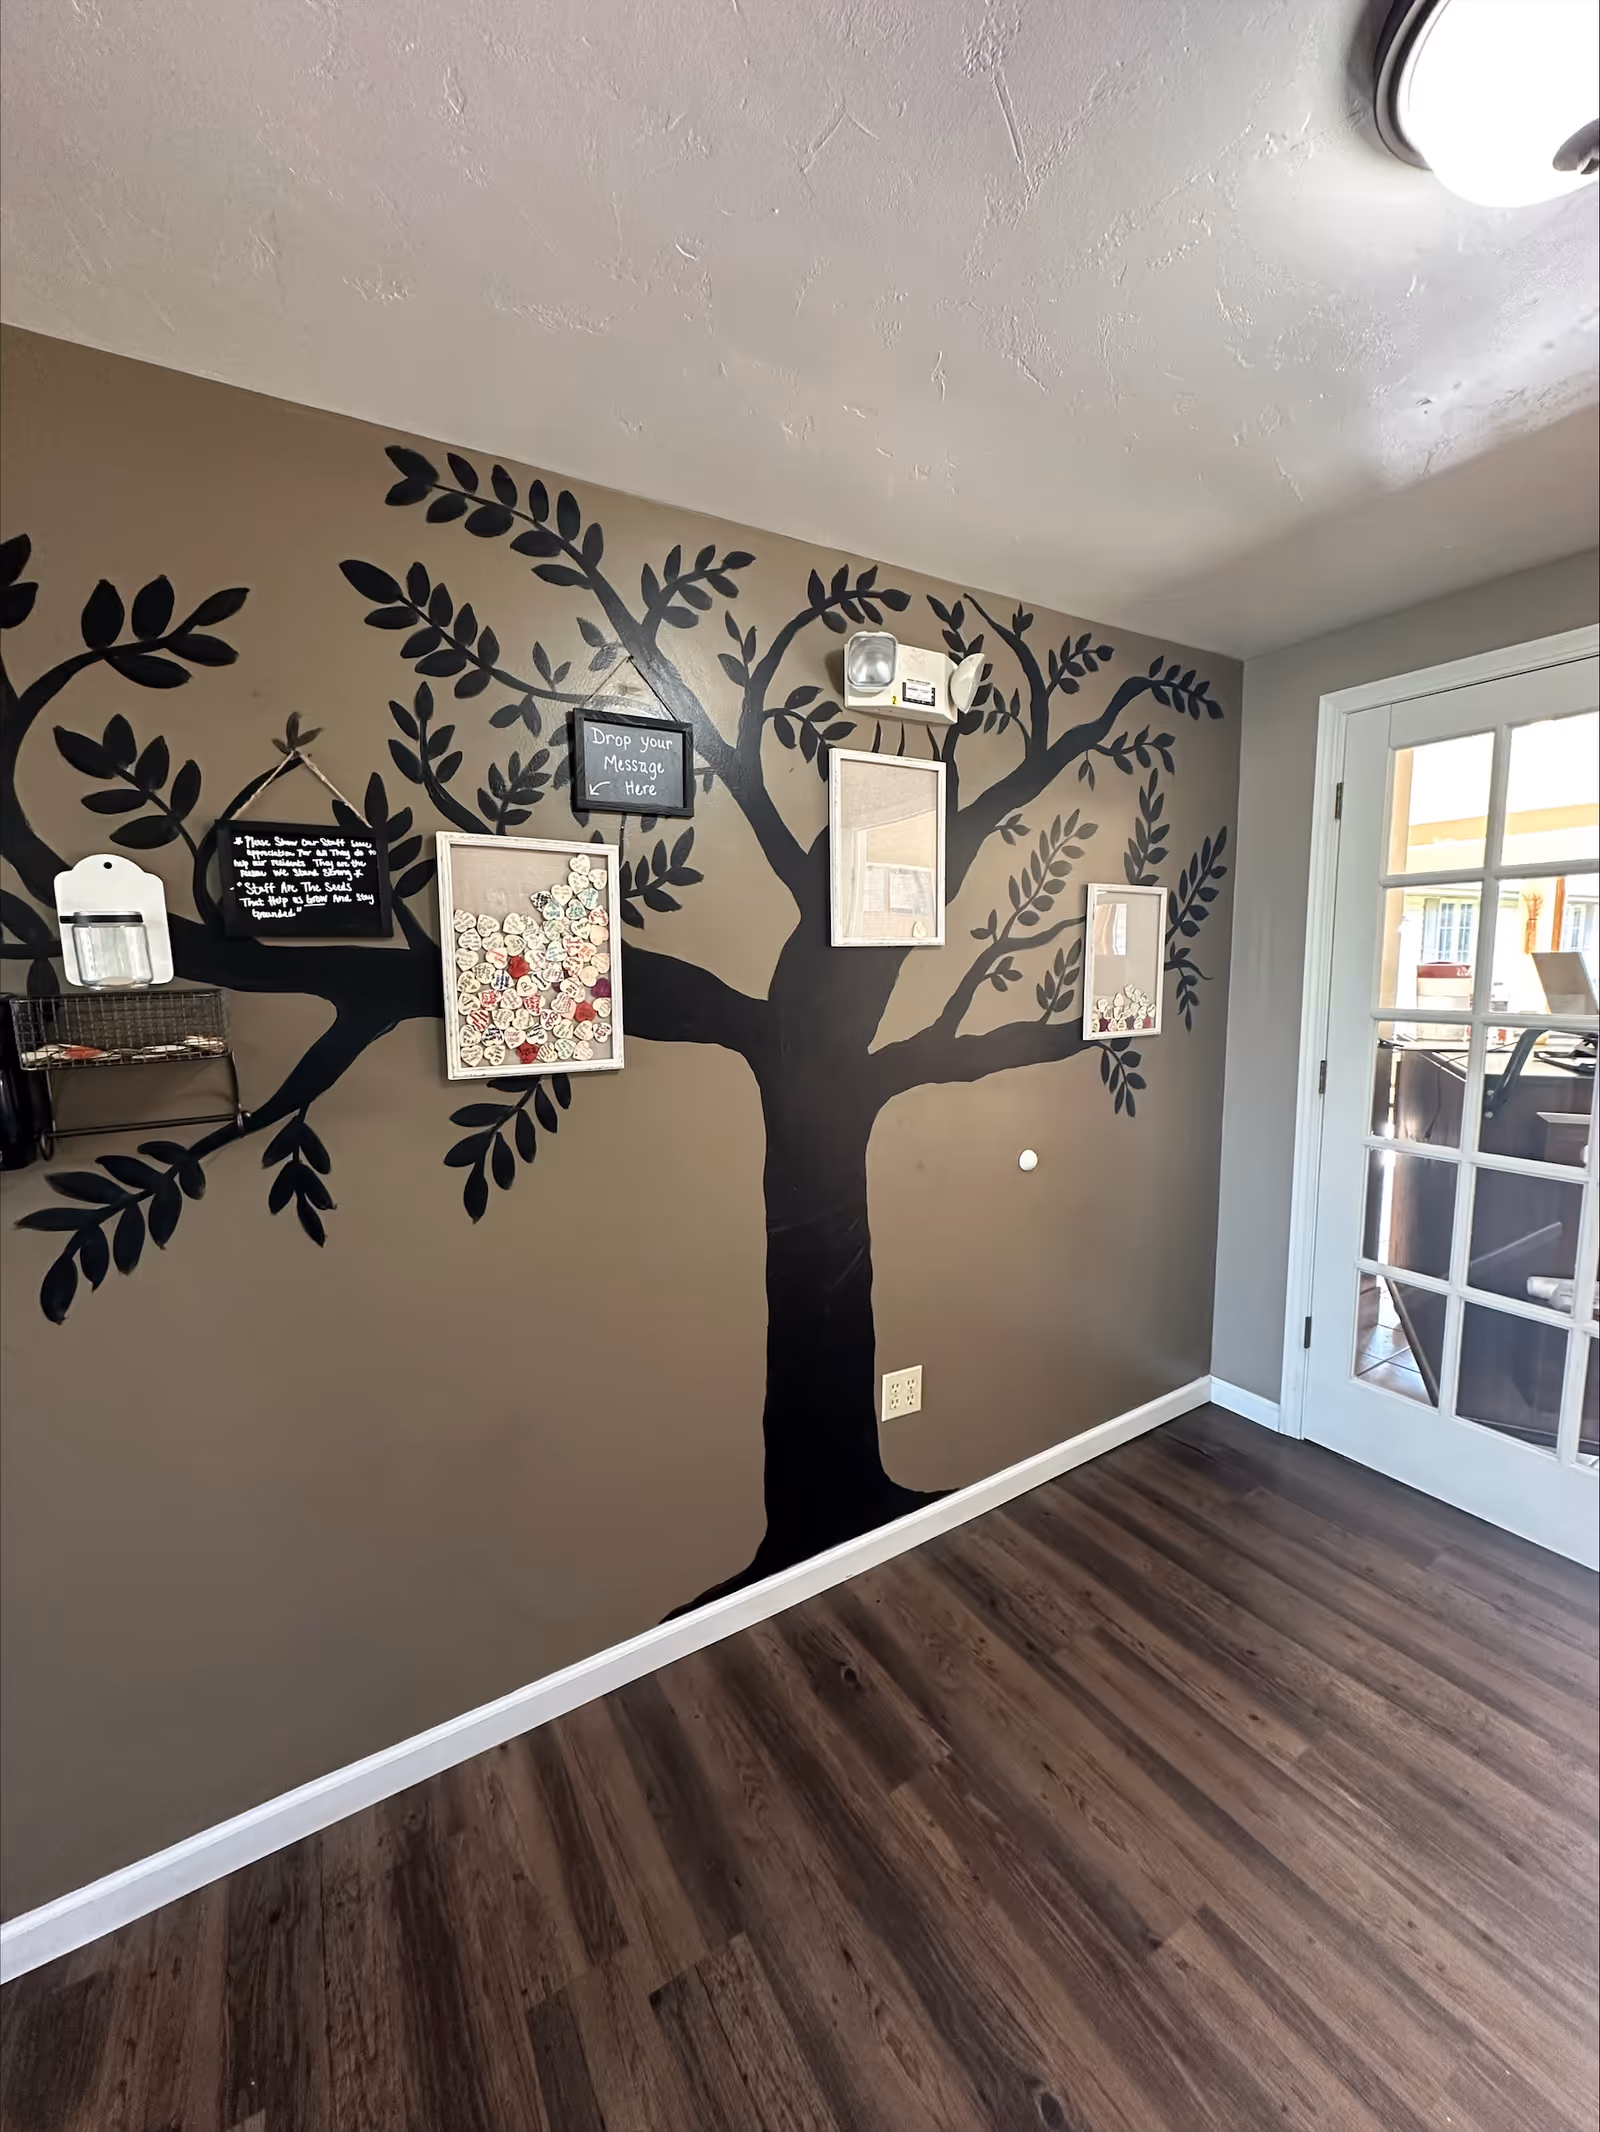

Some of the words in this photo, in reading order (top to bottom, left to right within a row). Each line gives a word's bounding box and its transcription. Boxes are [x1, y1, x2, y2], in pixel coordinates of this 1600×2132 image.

[892, 695, 897, 705] 2
[591, 727, 631, 750] Drop
[640, 736, 672, 753] your
[604, 754, 664, 780] Message
[625, 780, 657, 795] Here
[244, 835, 271, 848] Please
[274, 836, 298, 846] Show
[320, 837, 345, 847] Staff
[329, 849, 351, 860] They
[233, 859, 249, 870] help
[312, 859, 334, 870] They
[281, 881, 298, 894] Are
[300, 881, 322, 893] The
[324, 881, 352, 892] Seeds
[239, 897, 265, 908] That
[267, 895, 289, 908] Help
[332, 894, 352, 903] And
